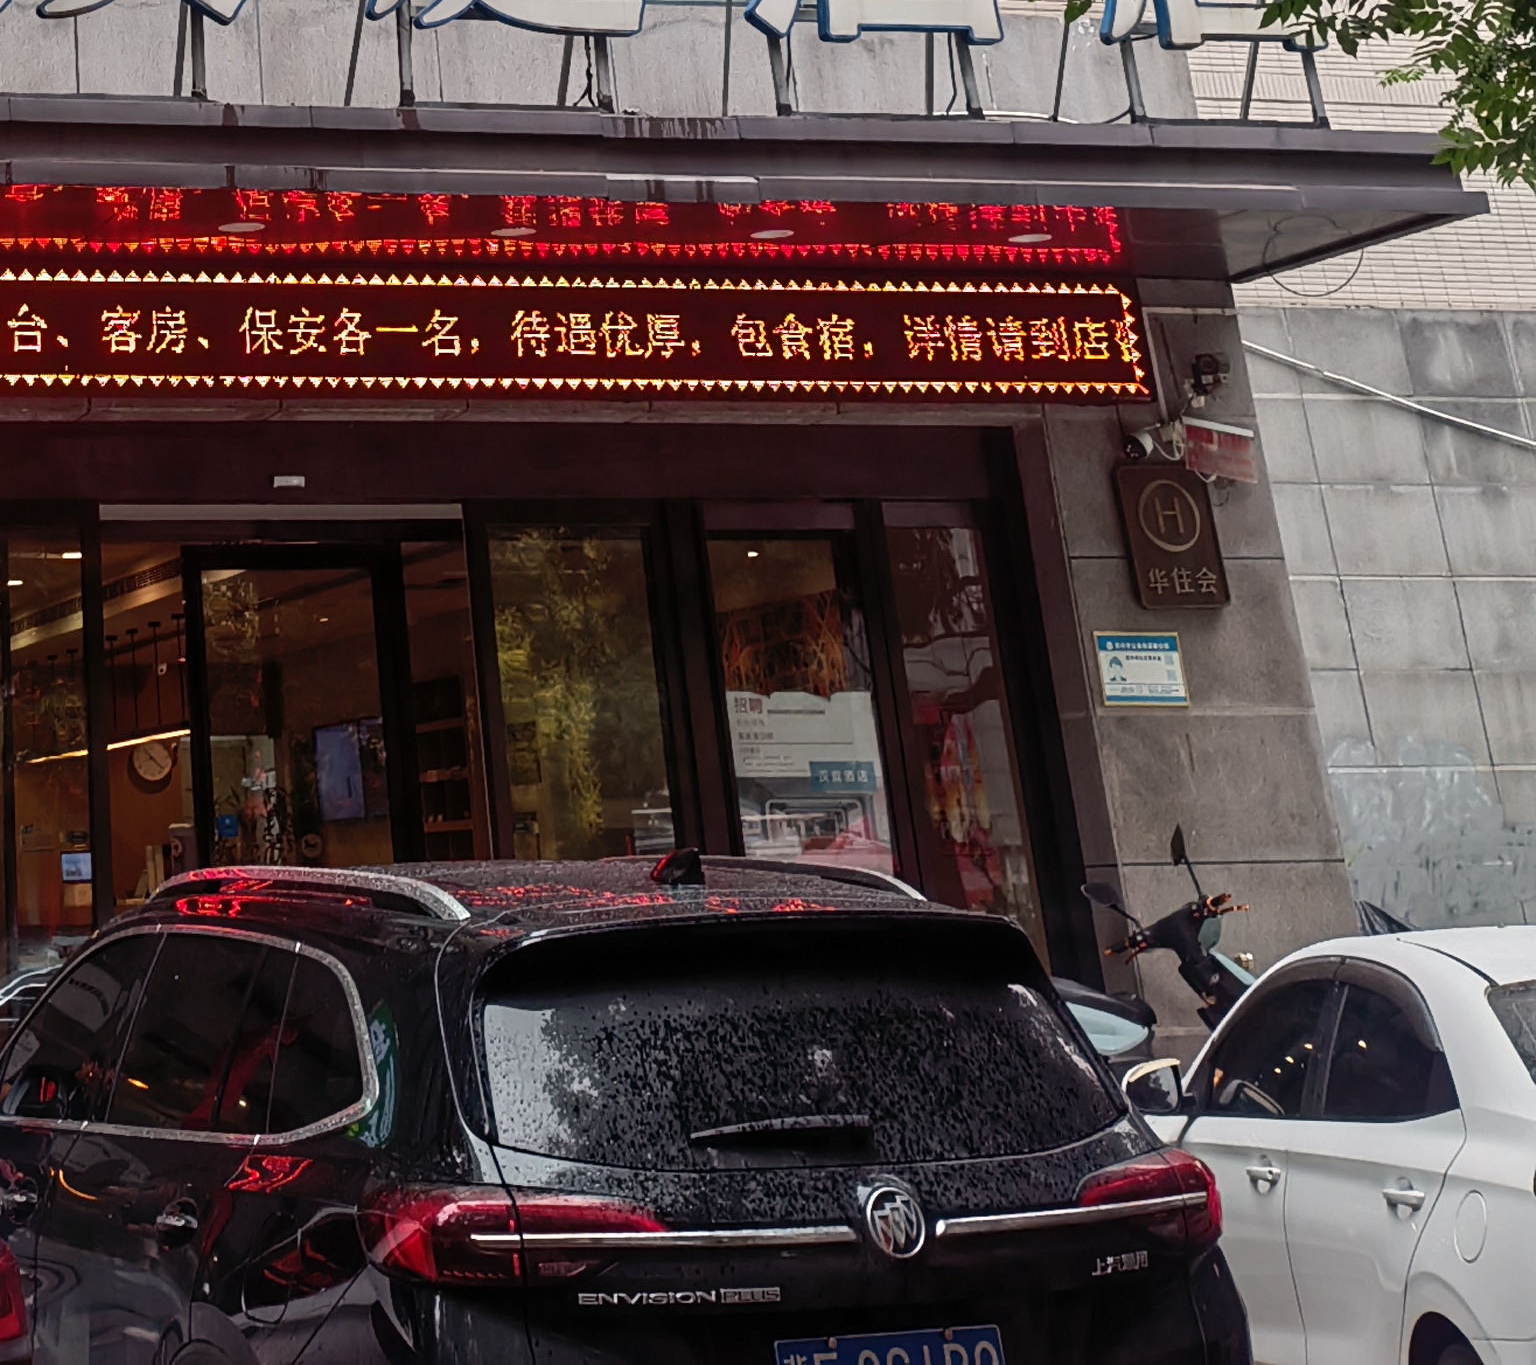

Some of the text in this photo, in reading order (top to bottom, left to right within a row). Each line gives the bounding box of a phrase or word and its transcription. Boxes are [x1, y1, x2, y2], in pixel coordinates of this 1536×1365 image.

[1147, 567, 1219, 595] 华住会
[577, 1287, 781, 1306] ENVISION PLUS
